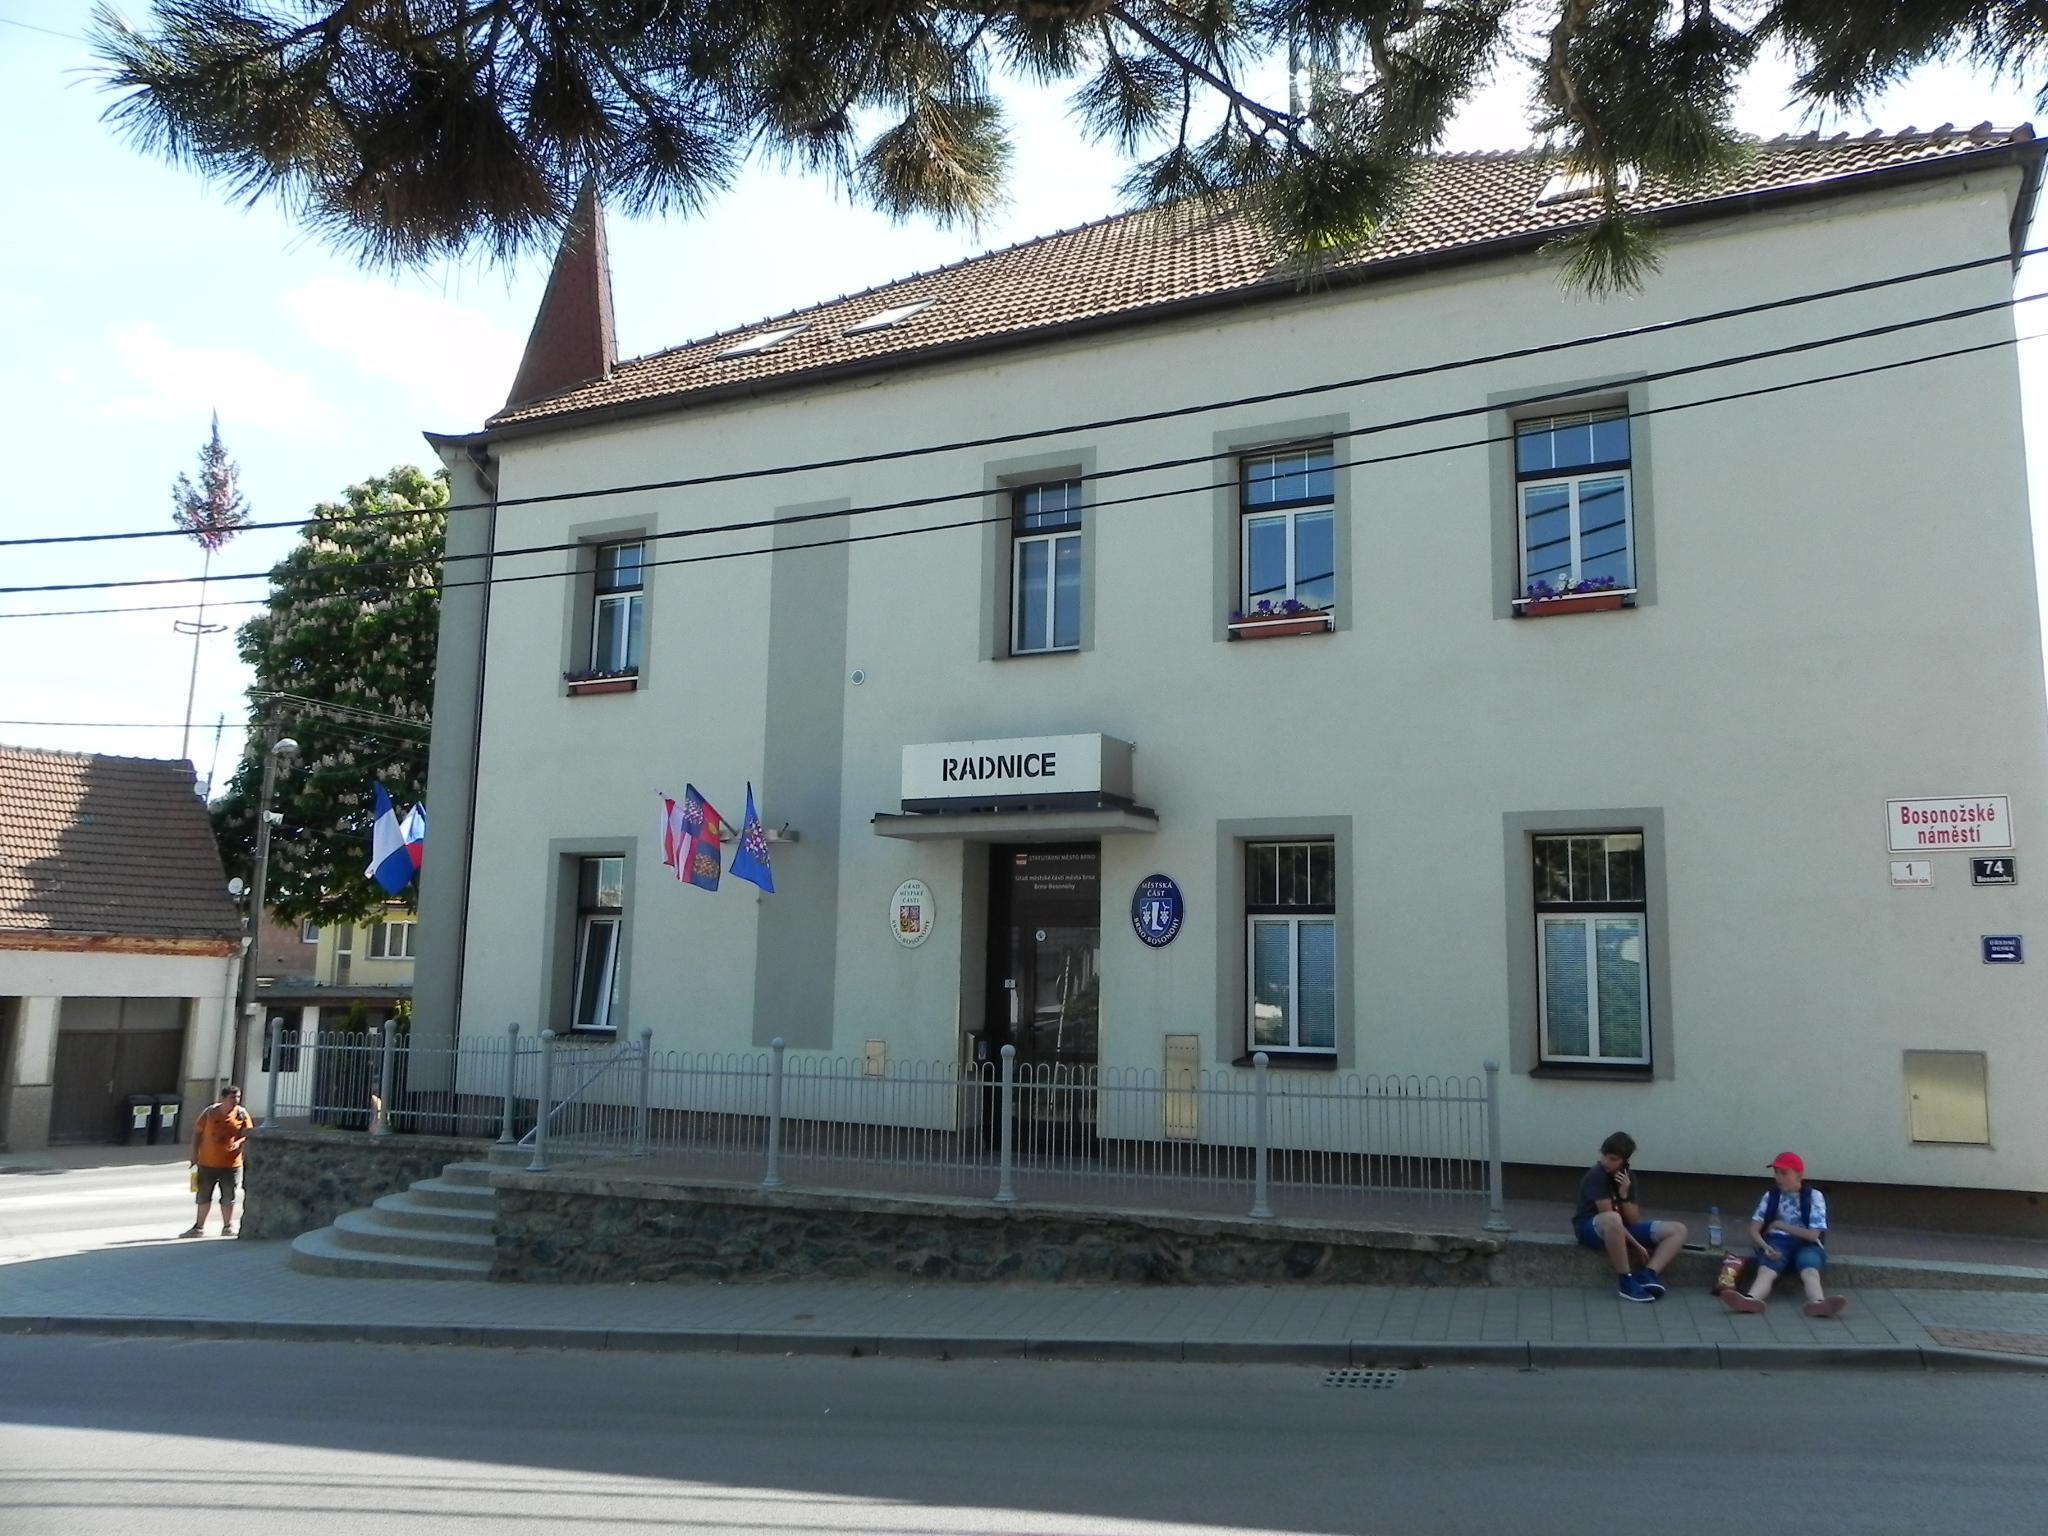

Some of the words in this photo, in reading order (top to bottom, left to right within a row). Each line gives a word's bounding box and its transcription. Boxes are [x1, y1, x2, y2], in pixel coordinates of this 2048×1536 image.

[942, 752, 1056, 782] RADNICE
[1901, 803, 1995, 825] Bosonožské
[1918, 824, 1981, 844] náměstí
[1905, 863, 1913, 876] 1
[1983, 860, 2004, 875] 74
[1141, 881, 1172, 889] MĚSTSKÁ
[1147, 889, 1165, 897] ČÁST
